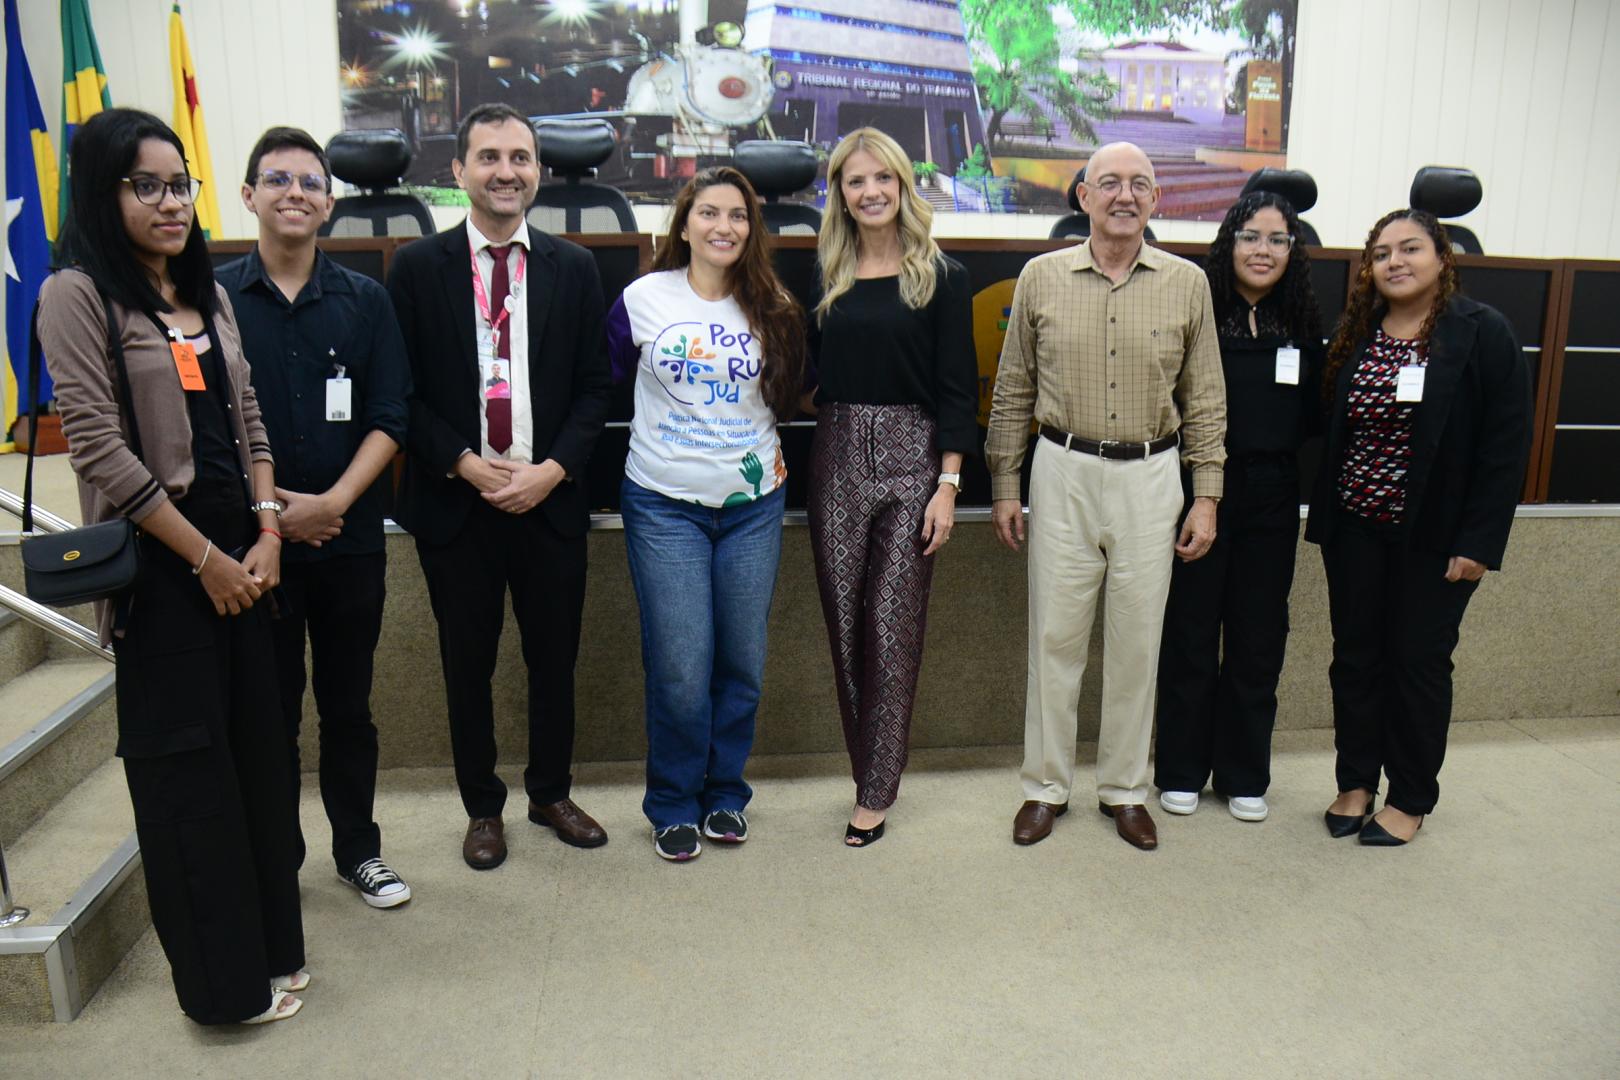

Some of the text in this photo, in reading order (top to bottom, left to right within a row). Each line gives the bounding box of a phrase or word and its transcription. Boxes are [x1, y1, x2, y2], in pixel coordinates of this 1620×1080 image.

[797, 72, 971, 98] TRIBUNAL REGIONAL DO TRABALHO
[728, 357, 761, 383] RU
[719, 417, 743, 426] Judicial
[744, 417, 752, 426] de
